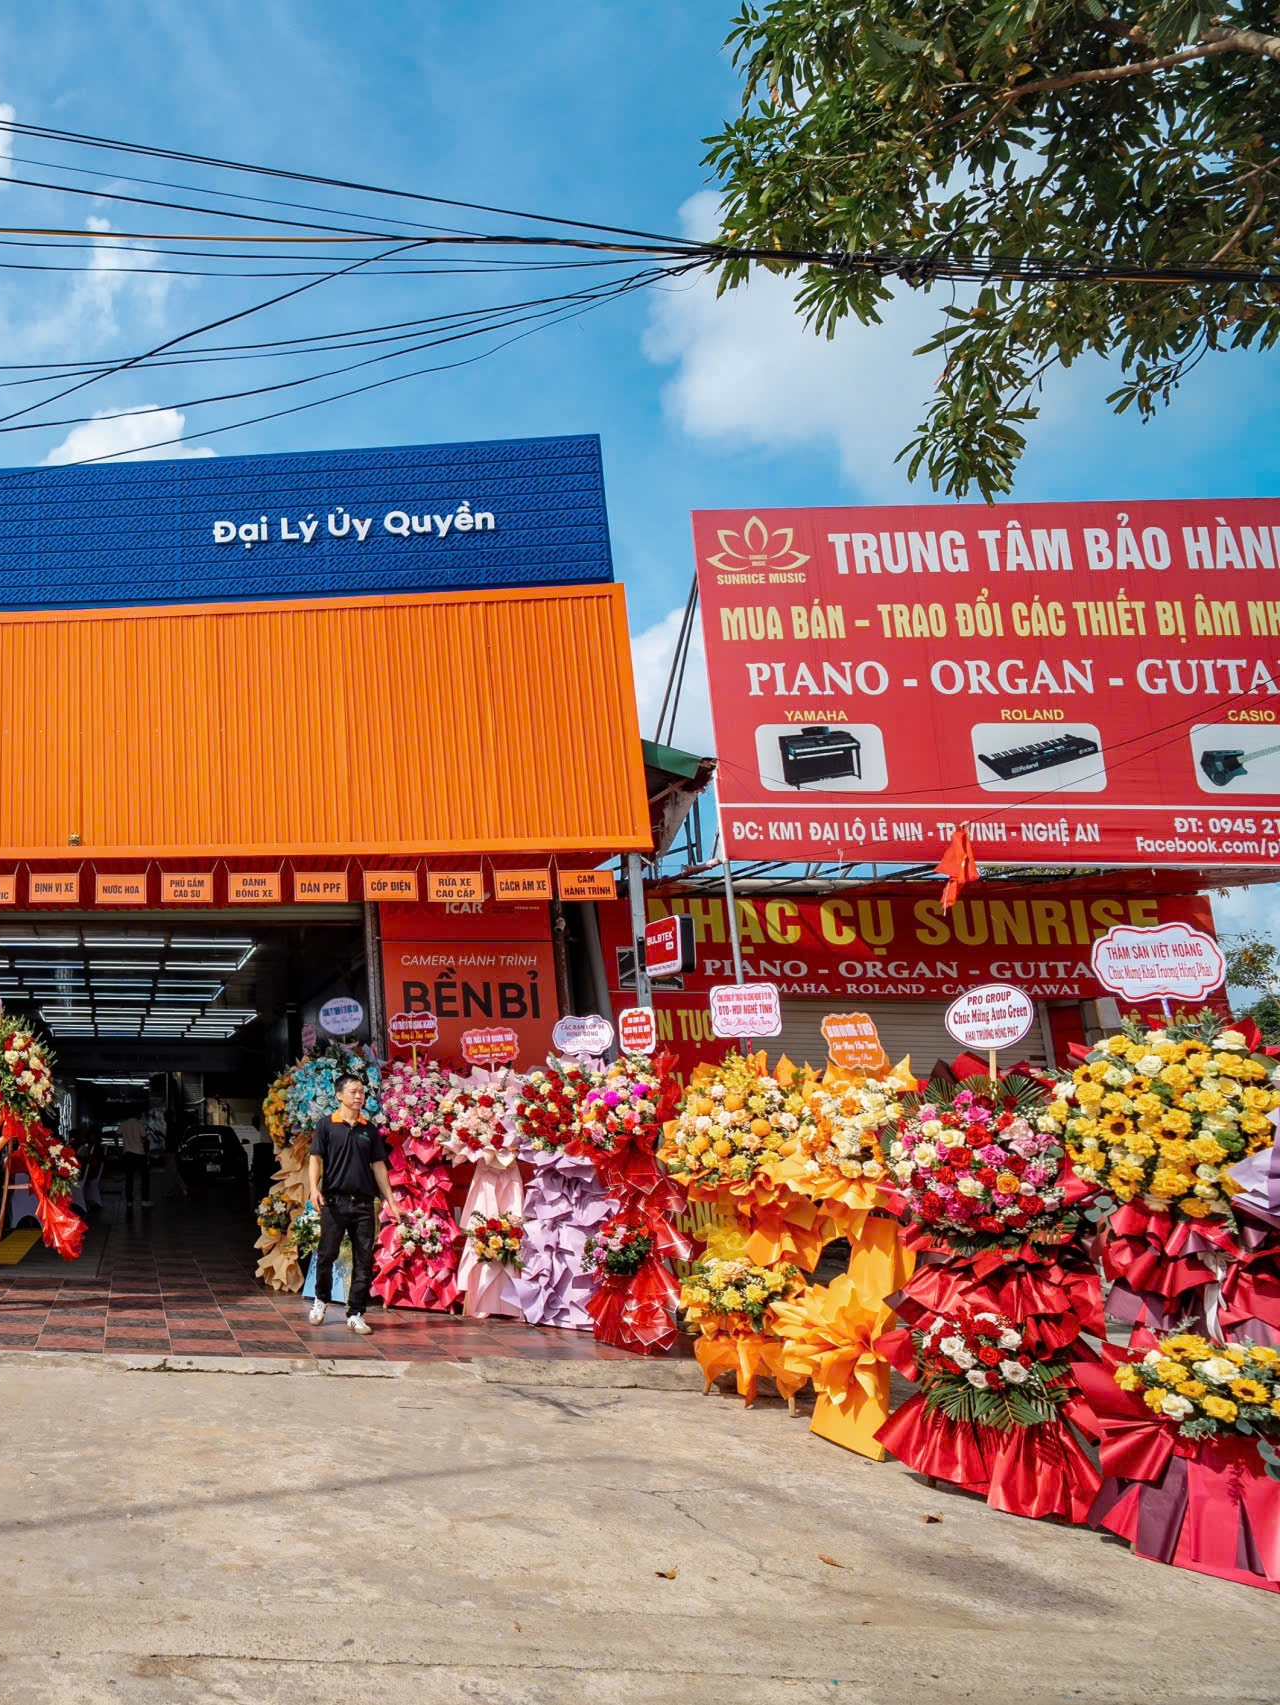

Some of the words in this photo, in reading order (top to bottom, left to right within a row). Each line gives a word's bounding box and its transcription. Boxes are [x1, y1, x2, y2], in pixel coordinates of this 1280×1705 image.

[213, 516, 268, 548] Đại
[280, 514, 319, 543] Lý
[328, 507, 372, 542] Ủy
[383, 501, 496, 538] Quyền
[827, 530, 970, 575] TRUNG
[978, 520, 1073, 572] TÂM
[1083, 512, 1172, 571] BẢO
[716, 573, 766, 585] SUNRICE
[769, 572, 807, 583] MUSIC
[720, 606, 783, 641] MUA
[793, 597, 846, 640] BÁN
[877, 603, 948, 639] TRAO
[955, 587, 1005, 638] ĐỔI
[1014, 595, 1067, 638] CÁC
[1072, 587, 1146, 637] THIẾT
[1157, 603, 1189, 644] BỊ
[1194, 595, 1240, 637] ÂM
[745, 661, 889, 696] PIANO
[929, 659, 1093, 695] ORGAN
[784, 709, 849, 722] YAMAHA
[1000, 708, 1065, 721] ROLAND
[1227, 709, 1276, 722] CASIO
[732, 821, 763, 840] ĐC:
[769, 821, 803, 840] KM1
[809, 821, 840, 845] ĐẠI
[844, 817, 866, 846] LỘ
[871, 817, 889, 841] LÊ
[892, 822, 924, 842] NIN
[1021, 817, 1070, 847] NGHỆ
[1075, 823, 1100, 842] AN
[1174, 817, 1204, 833] ĐT:
[1208, 818, 1257, 834] 0945
[460, 878, 471, 887] XE
[499, 879, 519, 892] CÁCH
[522, 879, 534, 891] ÂM
[536, 880, 547, 890] XE
[577, 875, 595, 883] CAM
[34, 883, 53, 895] ĐỊNH
[55, 883, 62, 895] VỊ
[64, 882, 74, 892] XE
[102, 883, 123, 894] NƯỚC
[124, 885, 140, 894] HOA
[300, 881, 320, 893] DÁN
[323, 883, 341, 893] PPF
[370, 879, 388, 892] CỐP
[390, 880, 411, 893] ĐIỆN
[588, 885, 611, 895] TRÌNH
[173, 889, 189, 898] CAO
[190, 889, 201, 898] SU
[235, 888, 260, 898] BÓNG
[262, 889, 273, 898] XE
[435, 889, 455, 898] CAO
[445, 902, 483, 914] ICAR
[820, 899, 894, 955] CỤ
[1150, 942, 1168, 960] VIỆT
[401, 954, 455, 966] CAMERA
[458, 954, 495, 966] HÀNH
[499, 953, 537, 966] TRÌNH
[703, 959, 816, 978] PIANO
[838, 959, 958, 978] ORGAN
[847, 983, 926, 994] ROLAND
[967, 994, 983, 1006] PRO
[985, 991, 1011, 1004] GROUP
[953, 1010, 970, 1025] Chúc
[991, 1006, 1007, 1021] Auto
[1007, 1004, 1028, 1019] Green
